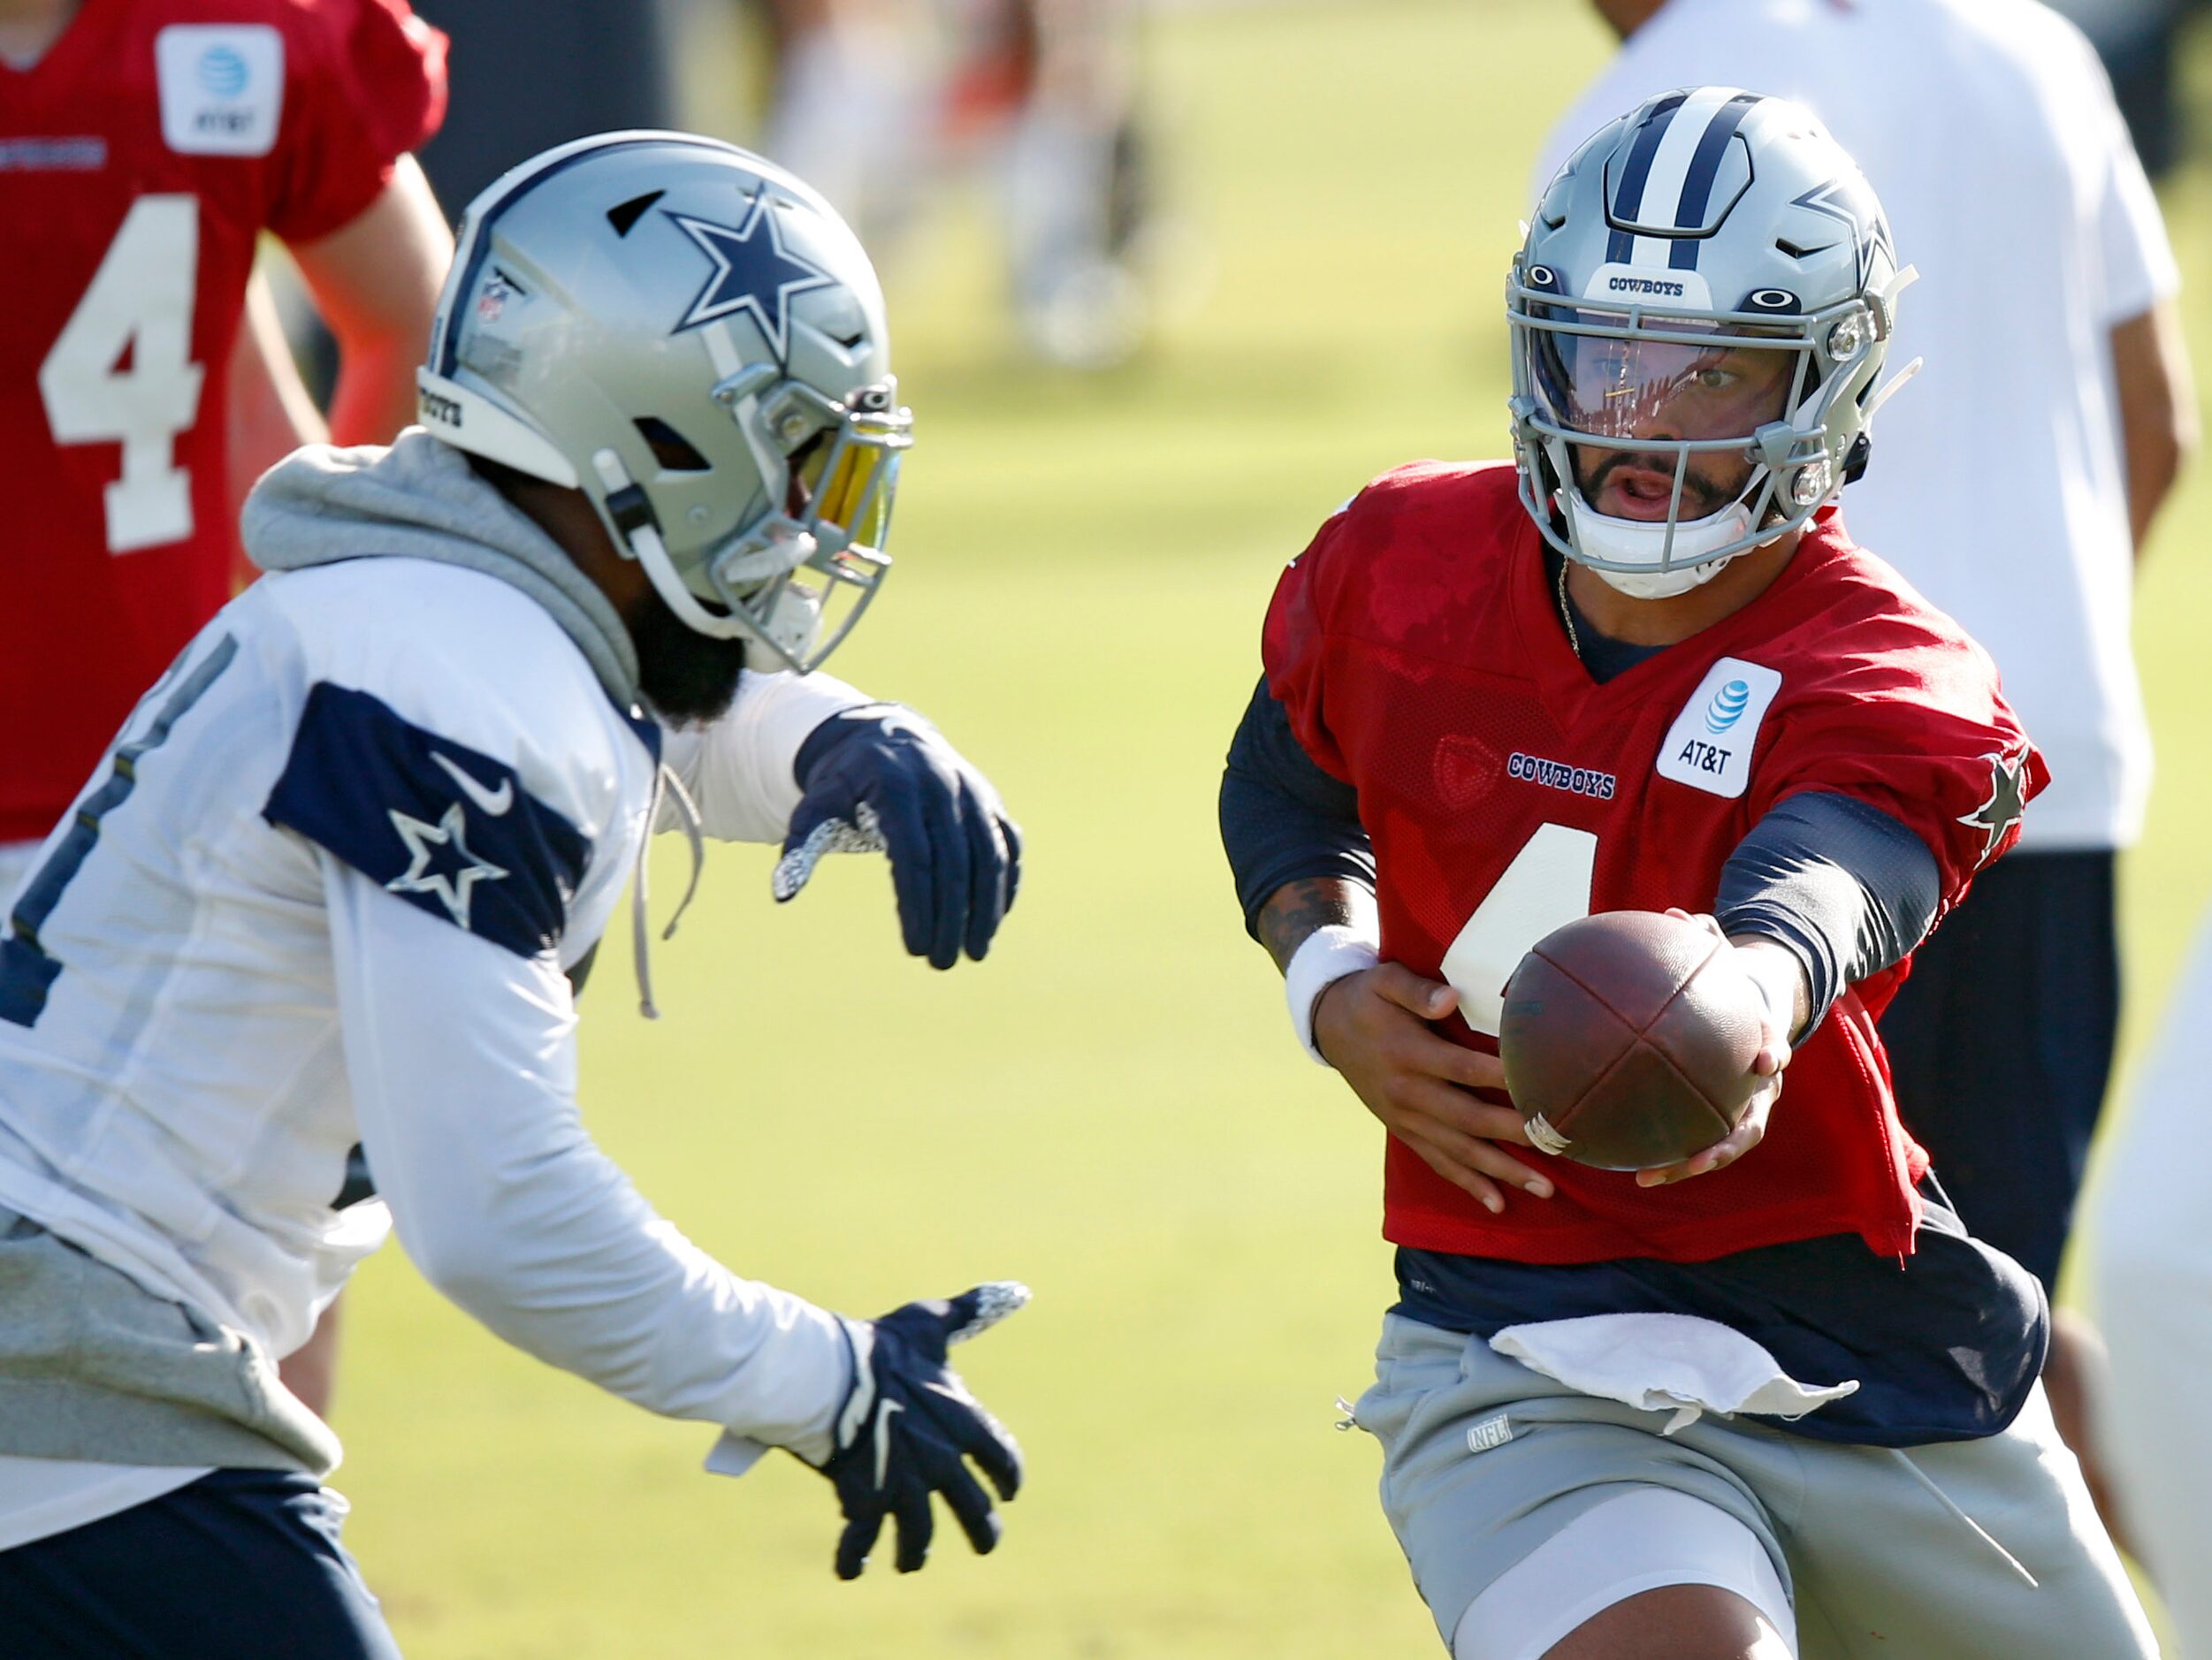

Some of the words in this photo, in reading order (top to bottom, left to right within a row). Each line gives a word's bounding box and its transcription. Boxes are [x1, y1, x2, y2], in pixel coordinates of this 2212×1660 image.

[1608, 277, 1683, 297] COWBOYS
[37, 193, 207, 557] 4
[1678, 739, 1732, 775] AT&T
[1506, 751, 1616, 800] COWBOYS
[1471, 1420, 1508, 1450] NFL
